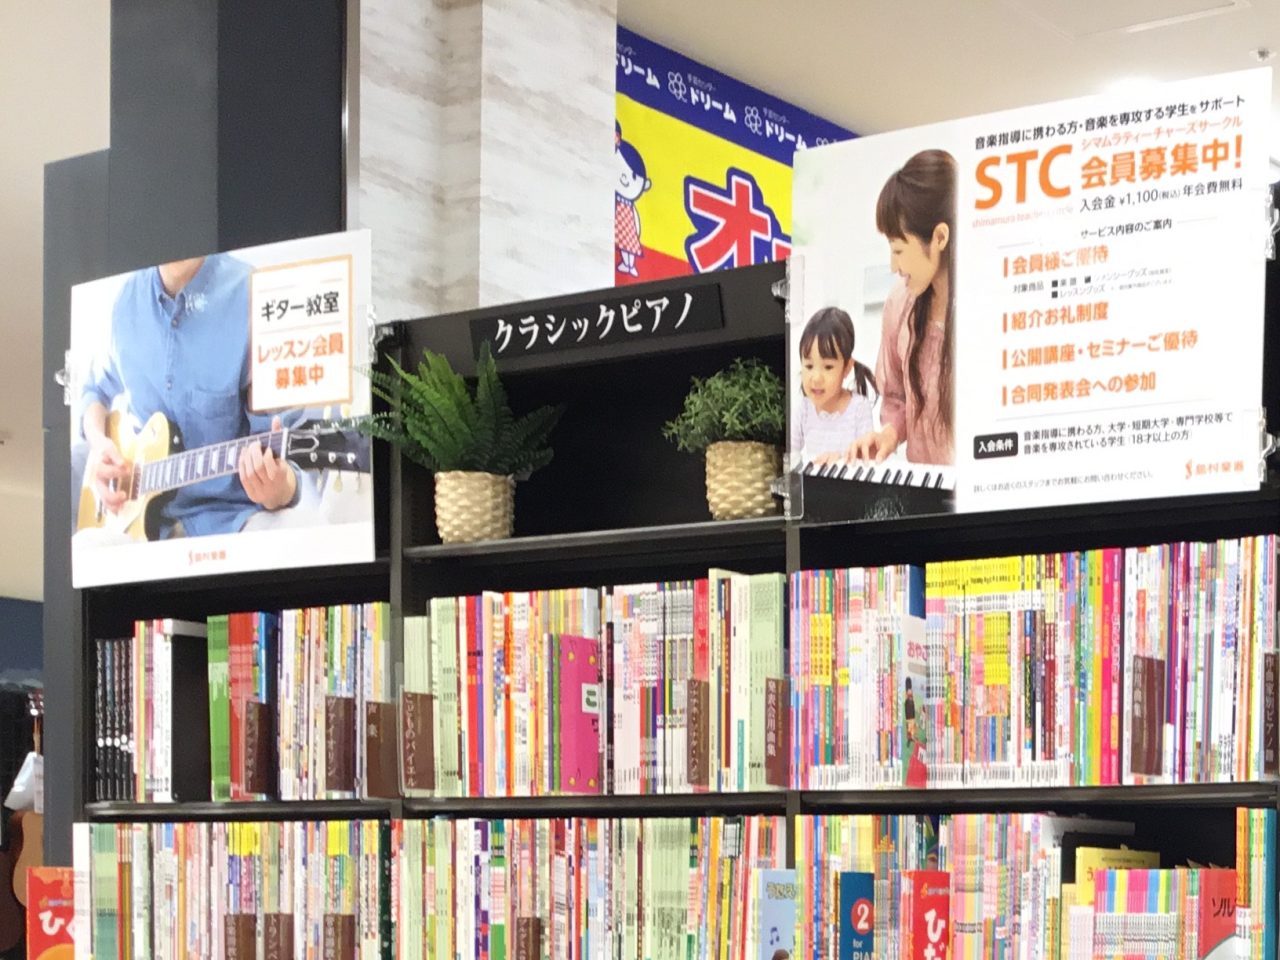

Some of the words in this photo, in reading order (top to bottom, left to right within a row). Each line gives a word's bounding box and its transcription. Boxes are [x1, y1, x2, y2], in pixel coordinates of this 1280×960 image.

[690, 86, 737, 123] ドリーム
[973, 143, 1073, 210] STC
[1079, 194, 1117, 214] 入会金
[1182, 176, 1244, 198] 年会費無料
[1080, 217, 1173, 239] サービス内容のご案内
[260, 291, 340, 322] ギター教室
[1010, 300, 1110, 332] 紹介お礼制度
[494, 292, 692, 354] クラシックピアノ
[257, 332, 345, 364] レッスン会員
[1010, 328, 1200, 370] 公開講座・セミナーご優待
[275, 362, 325, 390] 募集中
[1010, 371, 1158, 406] 合同発表会への参加
[857, 903, 870, 931] 2
[852, 937, 863, 949] for
